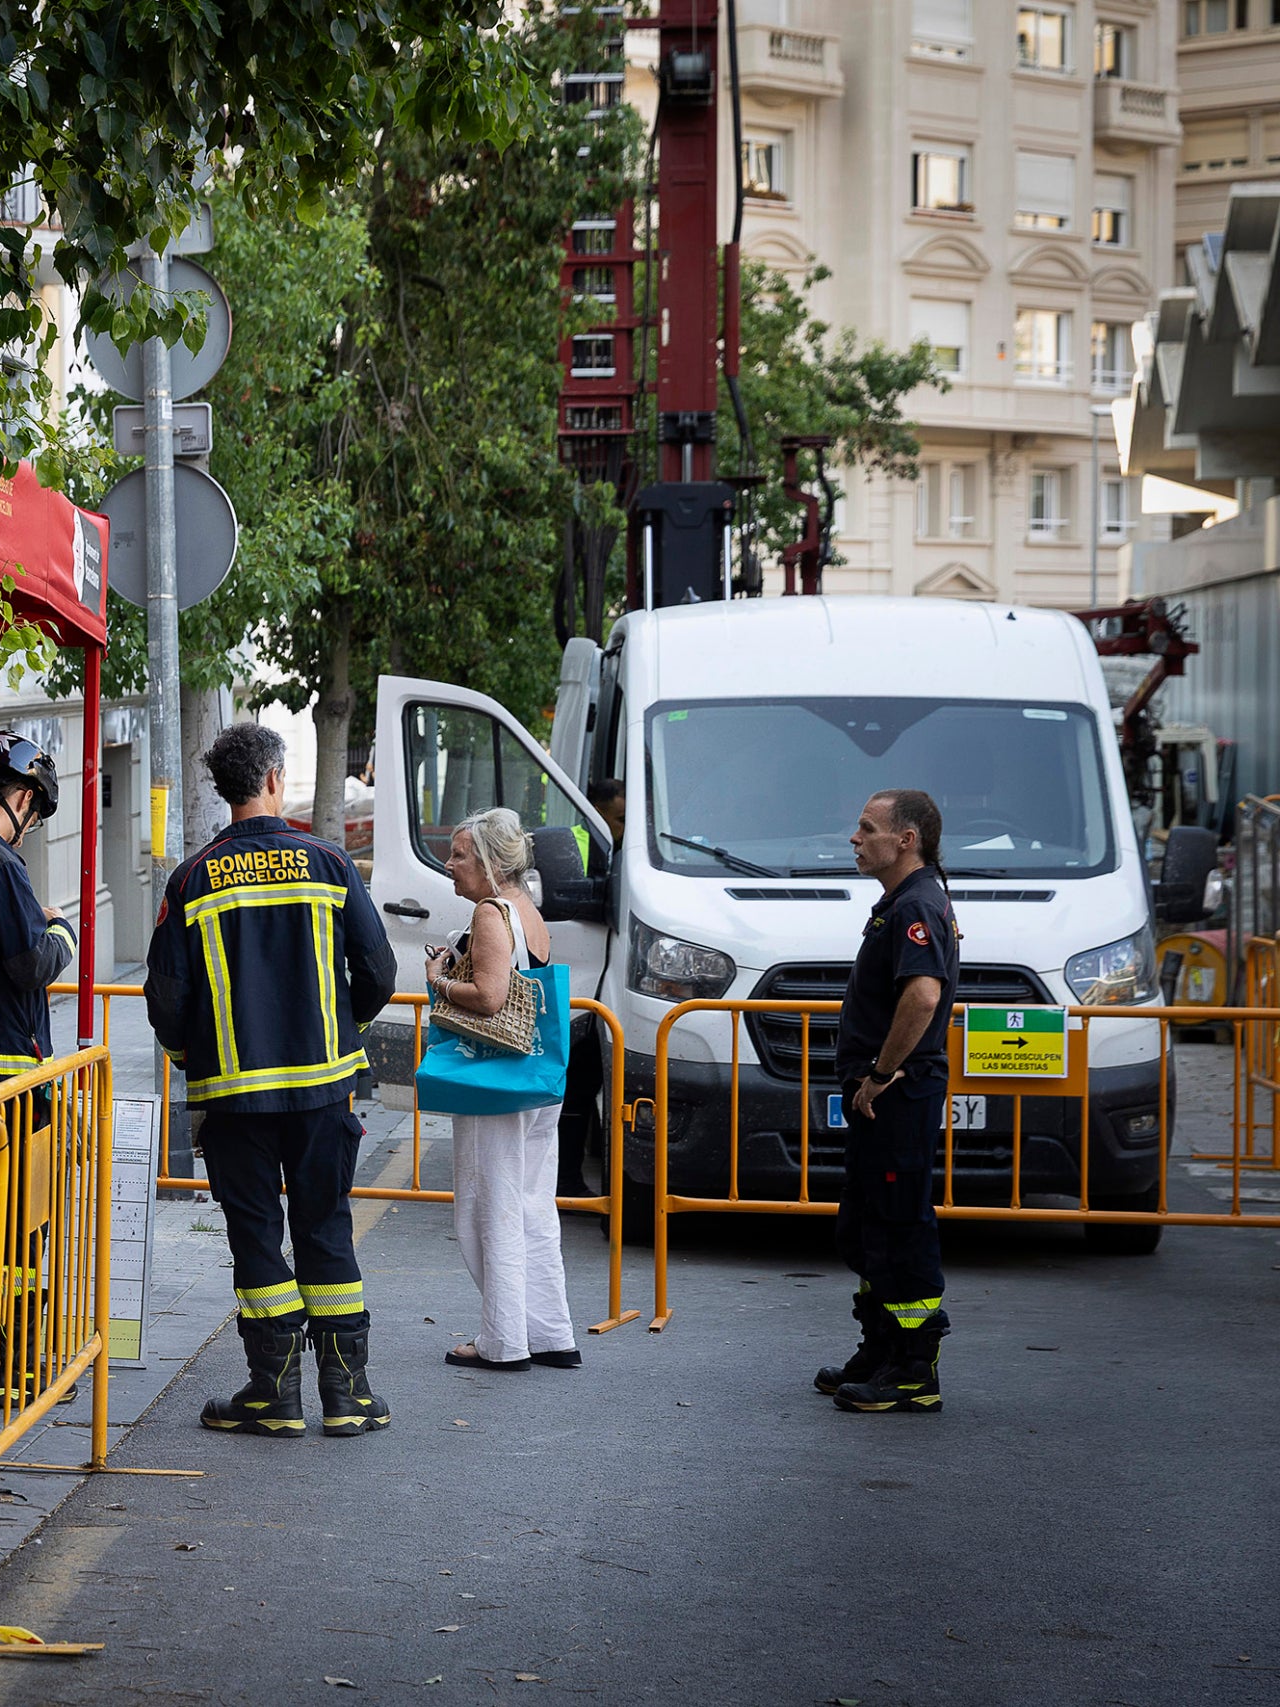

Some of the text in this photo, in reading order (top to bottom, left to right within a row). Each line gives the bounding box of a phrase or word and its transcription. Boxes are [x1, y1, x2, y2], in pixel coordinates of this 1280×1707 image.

[206, 849, 309, 877] BOMBERS
[210, 868, 311, 889] BARCELONA
[1014, 1053, 1061, 1061] DISCULPEN
